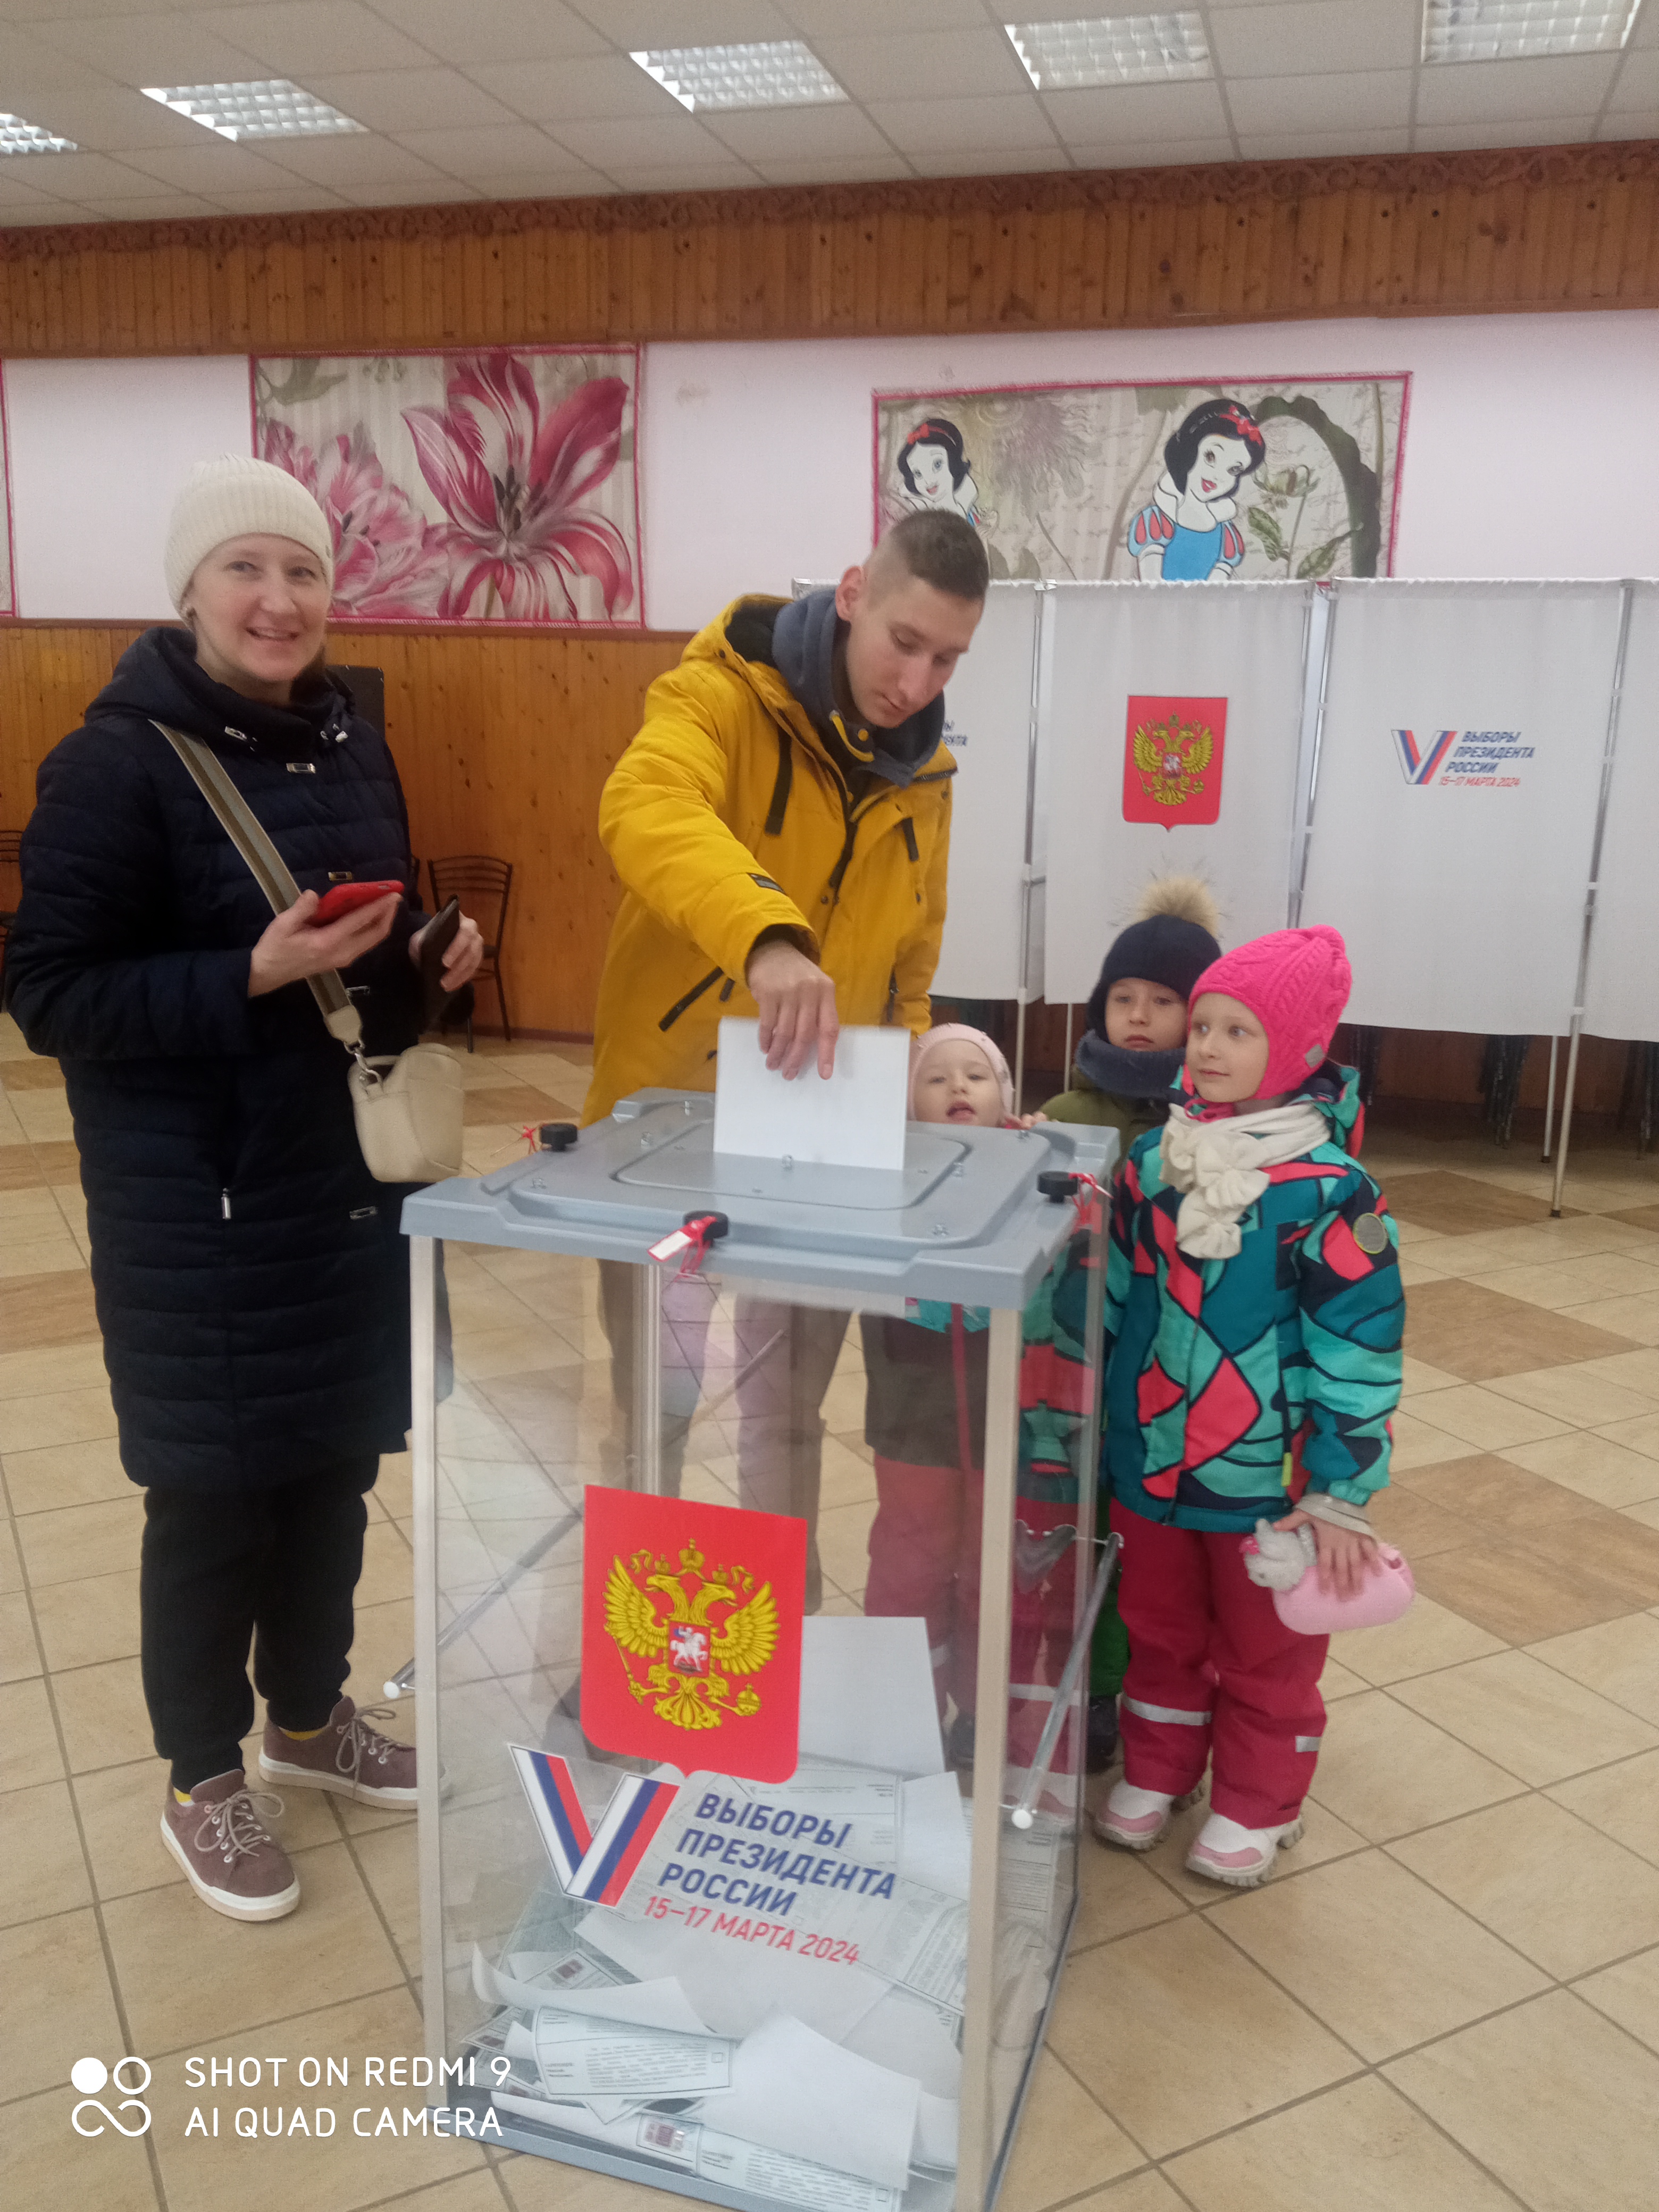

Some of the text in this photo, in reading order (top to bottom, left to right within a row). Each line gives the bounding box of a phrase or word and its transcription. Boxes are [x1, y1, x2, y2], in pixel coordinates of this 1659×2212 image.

[1454, 747, 1535, 759] ПРЕЗИДЕНТА
[1462, 731, 1521, 743] ВЫБОРЫ
[1445, 761, 1499, 773] РОССИИ
[1465, 777, 1496, 786] МАРТА
[1496, 777, 1520, 786] 2024
[694, 1792, 852, 1848] ВЫБОРЫ
[675, 1828, 895, 1899] ПРЕЗИДЕНТА
[657, 1862, 797, 1916] РОССИИ
[711, 1912, 795, 1951] МАРТА
[798, 1933, 859, 1965] 2024
